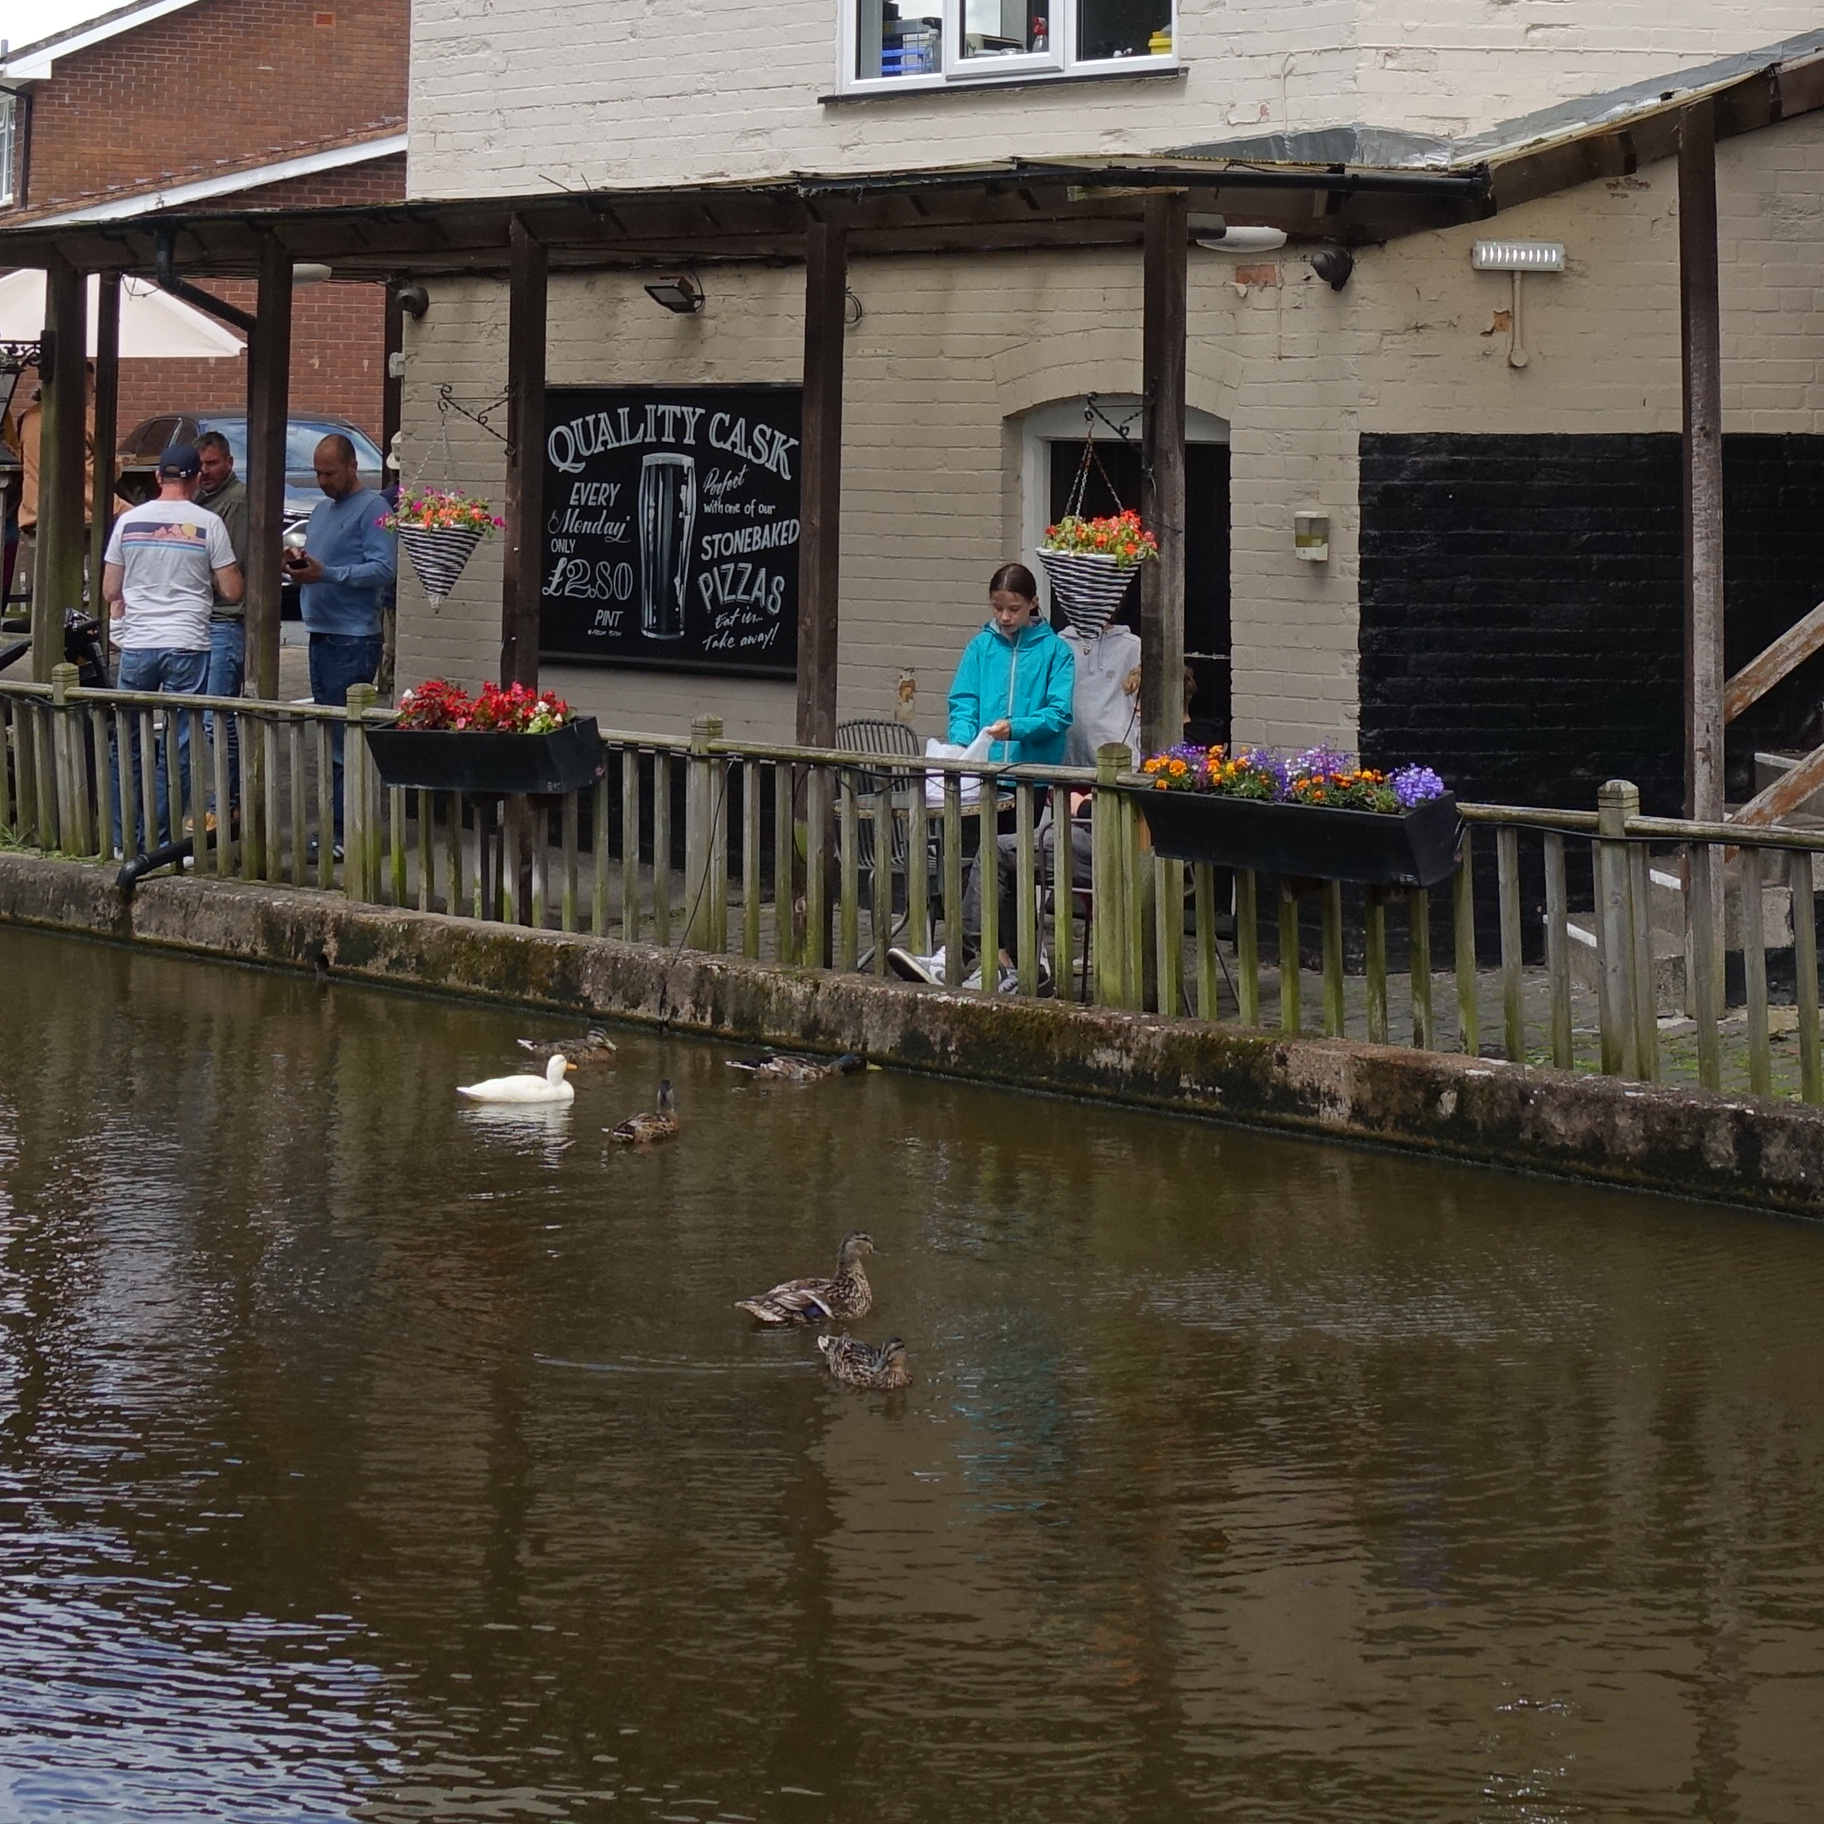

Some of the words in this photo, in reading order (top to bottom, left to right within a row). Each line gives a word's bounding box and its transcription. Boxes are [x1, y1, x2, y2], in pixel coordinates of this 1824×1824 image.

[548, 404, 705, 474] QUALITY
[709, 412, 799, 481] CASK
[569, 482, 621, 507] EVERY
[703, 464, 750, 500] Perfect
[703, 499, 723, 513] with
[724, 503, 740, 514] one
[744, 499, 756, 518] of
[758, 504, 776, 514] our
[547, 508, 631, 543] Monday
[701, 519, 800, 561] STONEBAKED
[550, 538, 576, 553] ONLY
[542, 557, 633, 600] £2.80
[697, 562, 785, 615] PIZZAS
[594, 609, 624, 627] PINT
[715, 607, 740, 629] Eat
[702, 630, 735, 651] Take
[740, 622, 780, 649] away!
